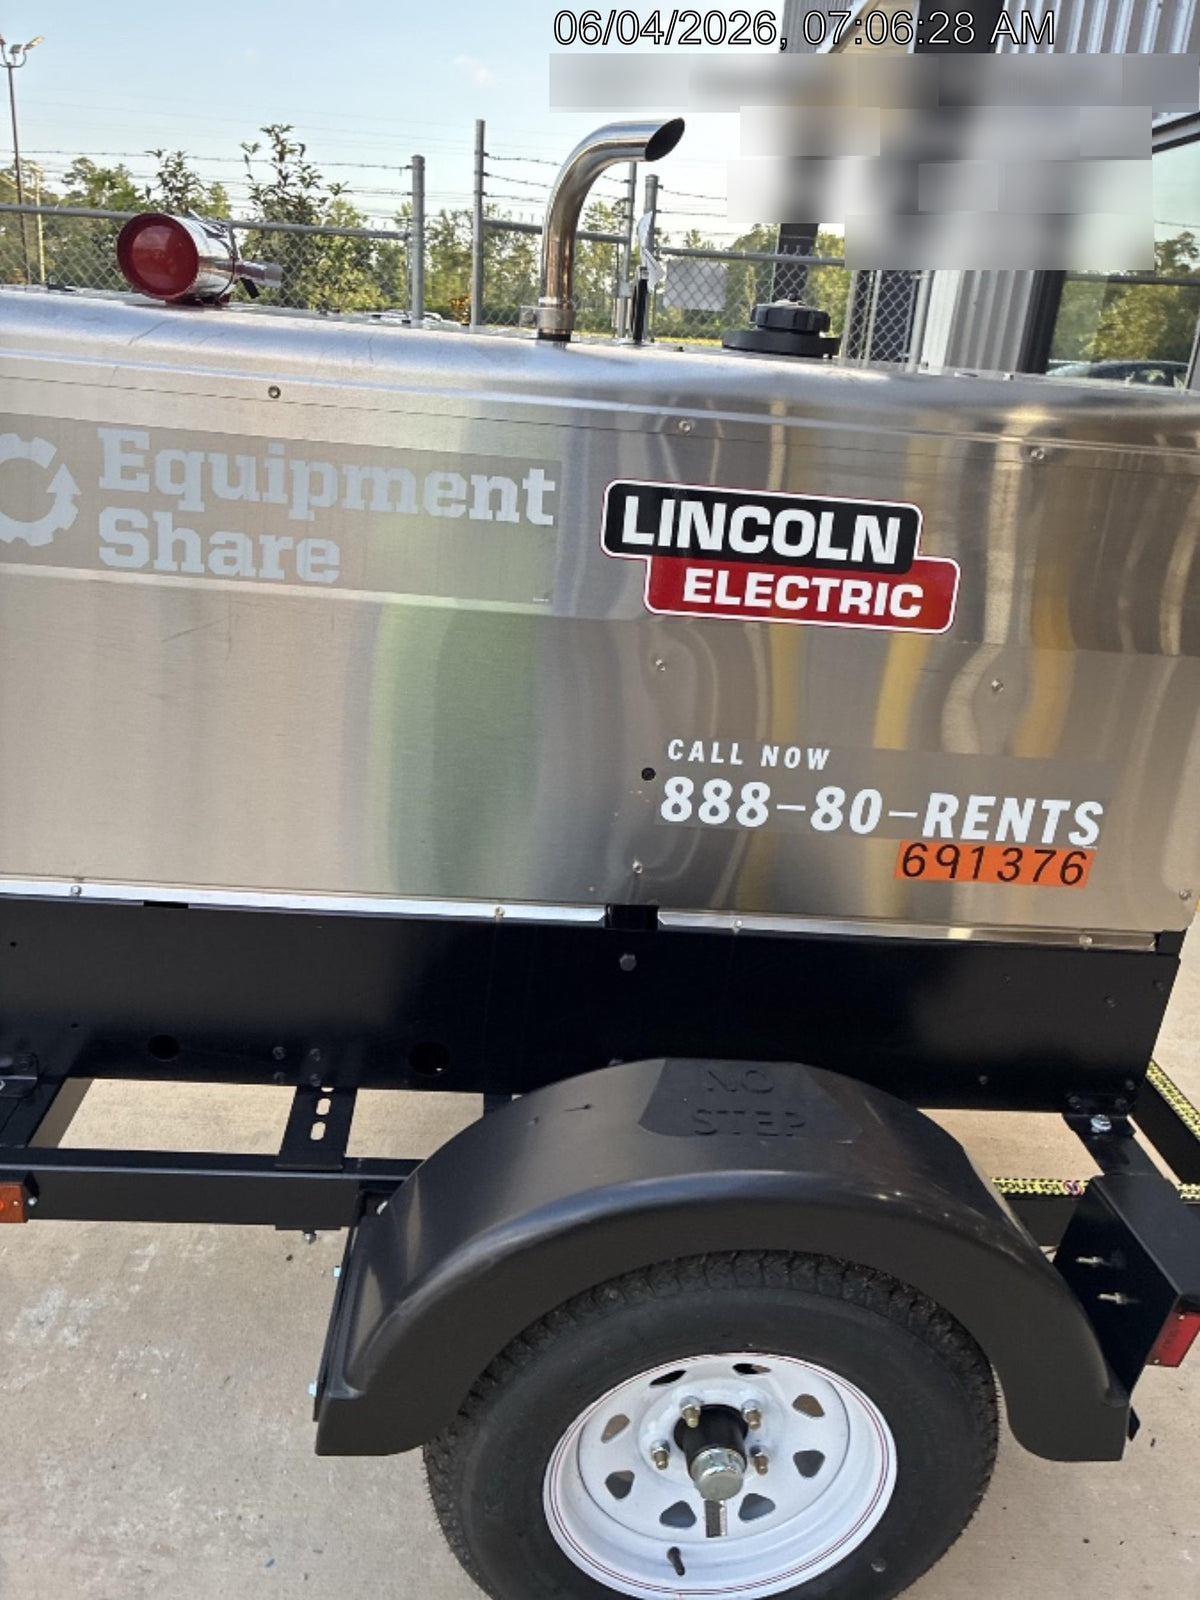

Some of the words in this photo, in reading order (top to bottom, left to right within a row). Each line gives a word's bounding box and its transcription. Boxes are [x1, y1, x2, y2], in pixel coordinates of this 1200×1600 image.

[98, 427, 556, 526] Equipment
[98, 506, 341, 584] Share
[621, 495, 901, 564] LINCOLN
[682, 567, 924, 619] ELECTRIC
[667, 738, 743, 766] CALL
[760, 744, 831, 771] NOW
[660, 775, 1104, 846] 888-80-RENTS
[900, 842, 1088, 886] 691376
